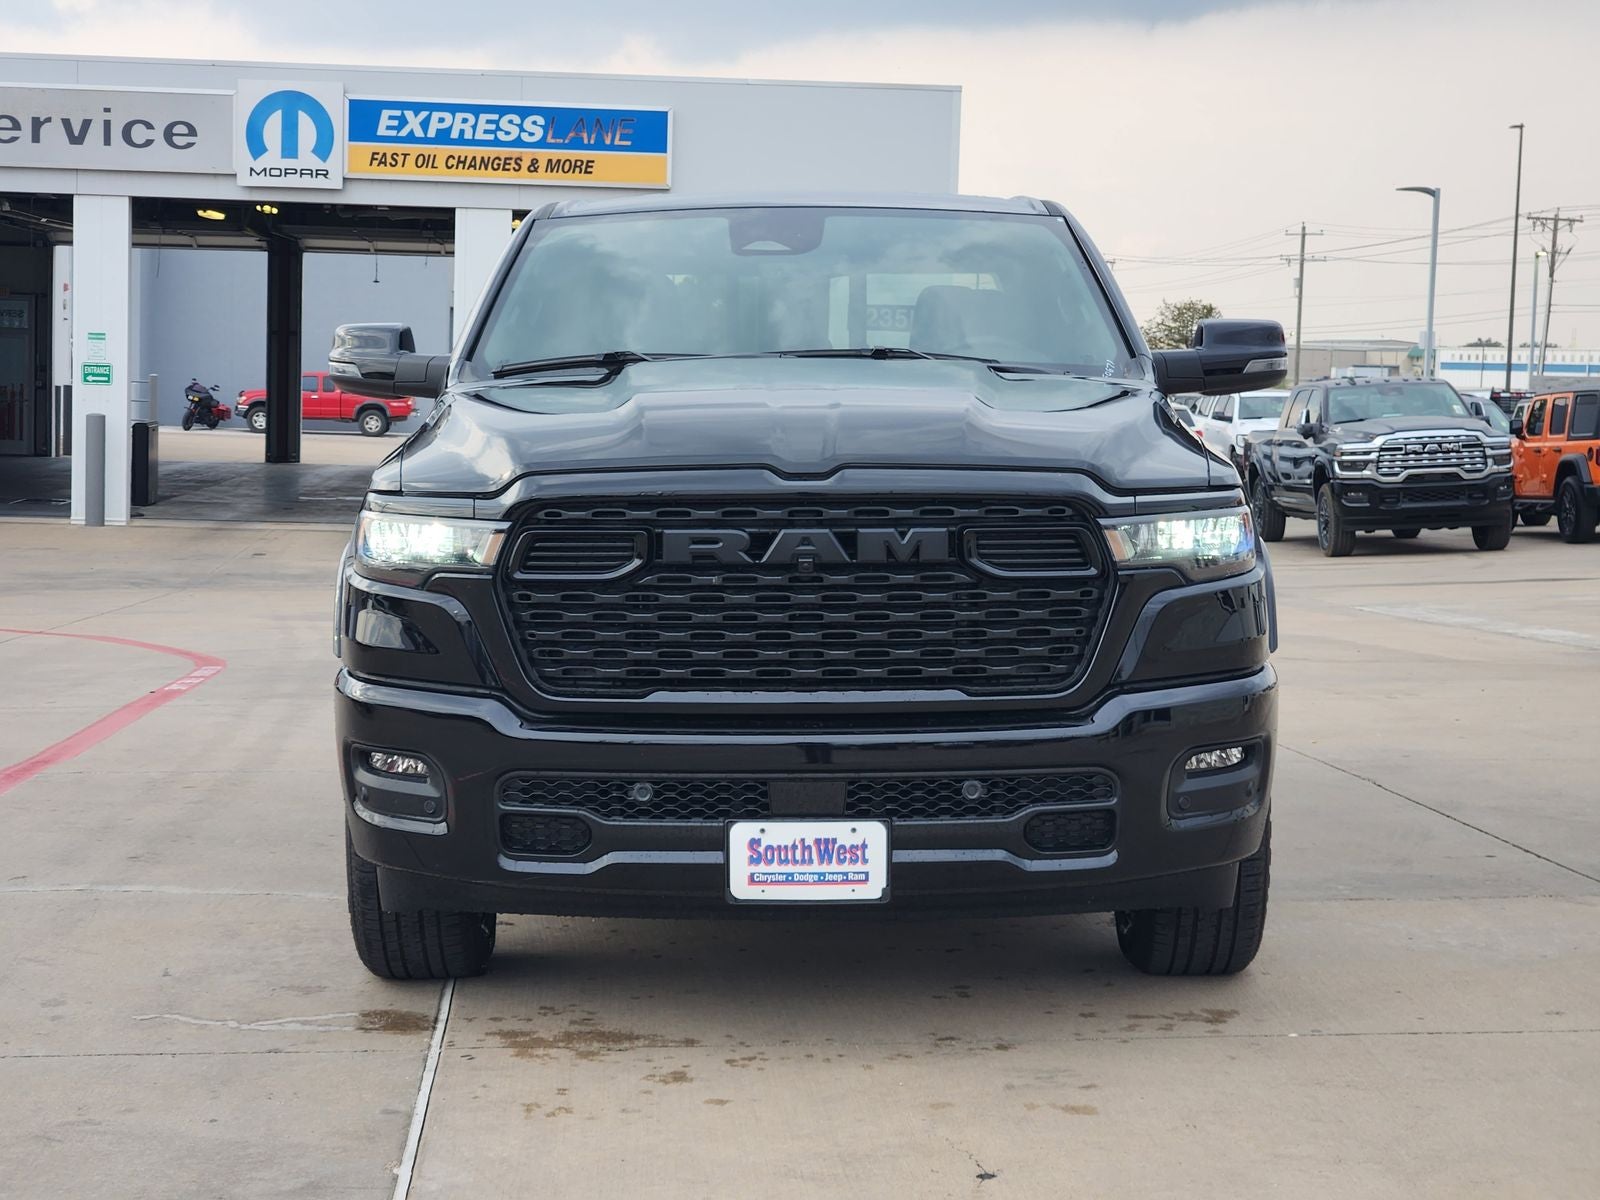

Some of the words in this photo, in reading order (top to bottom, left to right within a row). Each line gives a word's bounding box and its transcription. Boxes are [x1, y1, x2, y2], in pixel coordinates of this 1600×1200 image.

[0, 107, 198, 150] ervice
[369, 151, 410, 169] FAST
[414, 153, 439, 170] OIL
[445, 154, 523, 173] CHANGES
[527, 159, 540, 173] &
[545, 158, 595, 175] MORE
[249, 166, 330, 180] MOPAR
[84, 366, 110, 375] ENTRANCE
[1406, 443, 1459, 454] RAM
[662, 527, 949, 564] RAM
[747, 837, 869, 867] SouthWest
[753, 873, 786, 883] Chrysler
[793, 873, 818, 882] Dodge
[824, 872, 843, 882] Jeep
[848, 872, 865, 881] Ram
